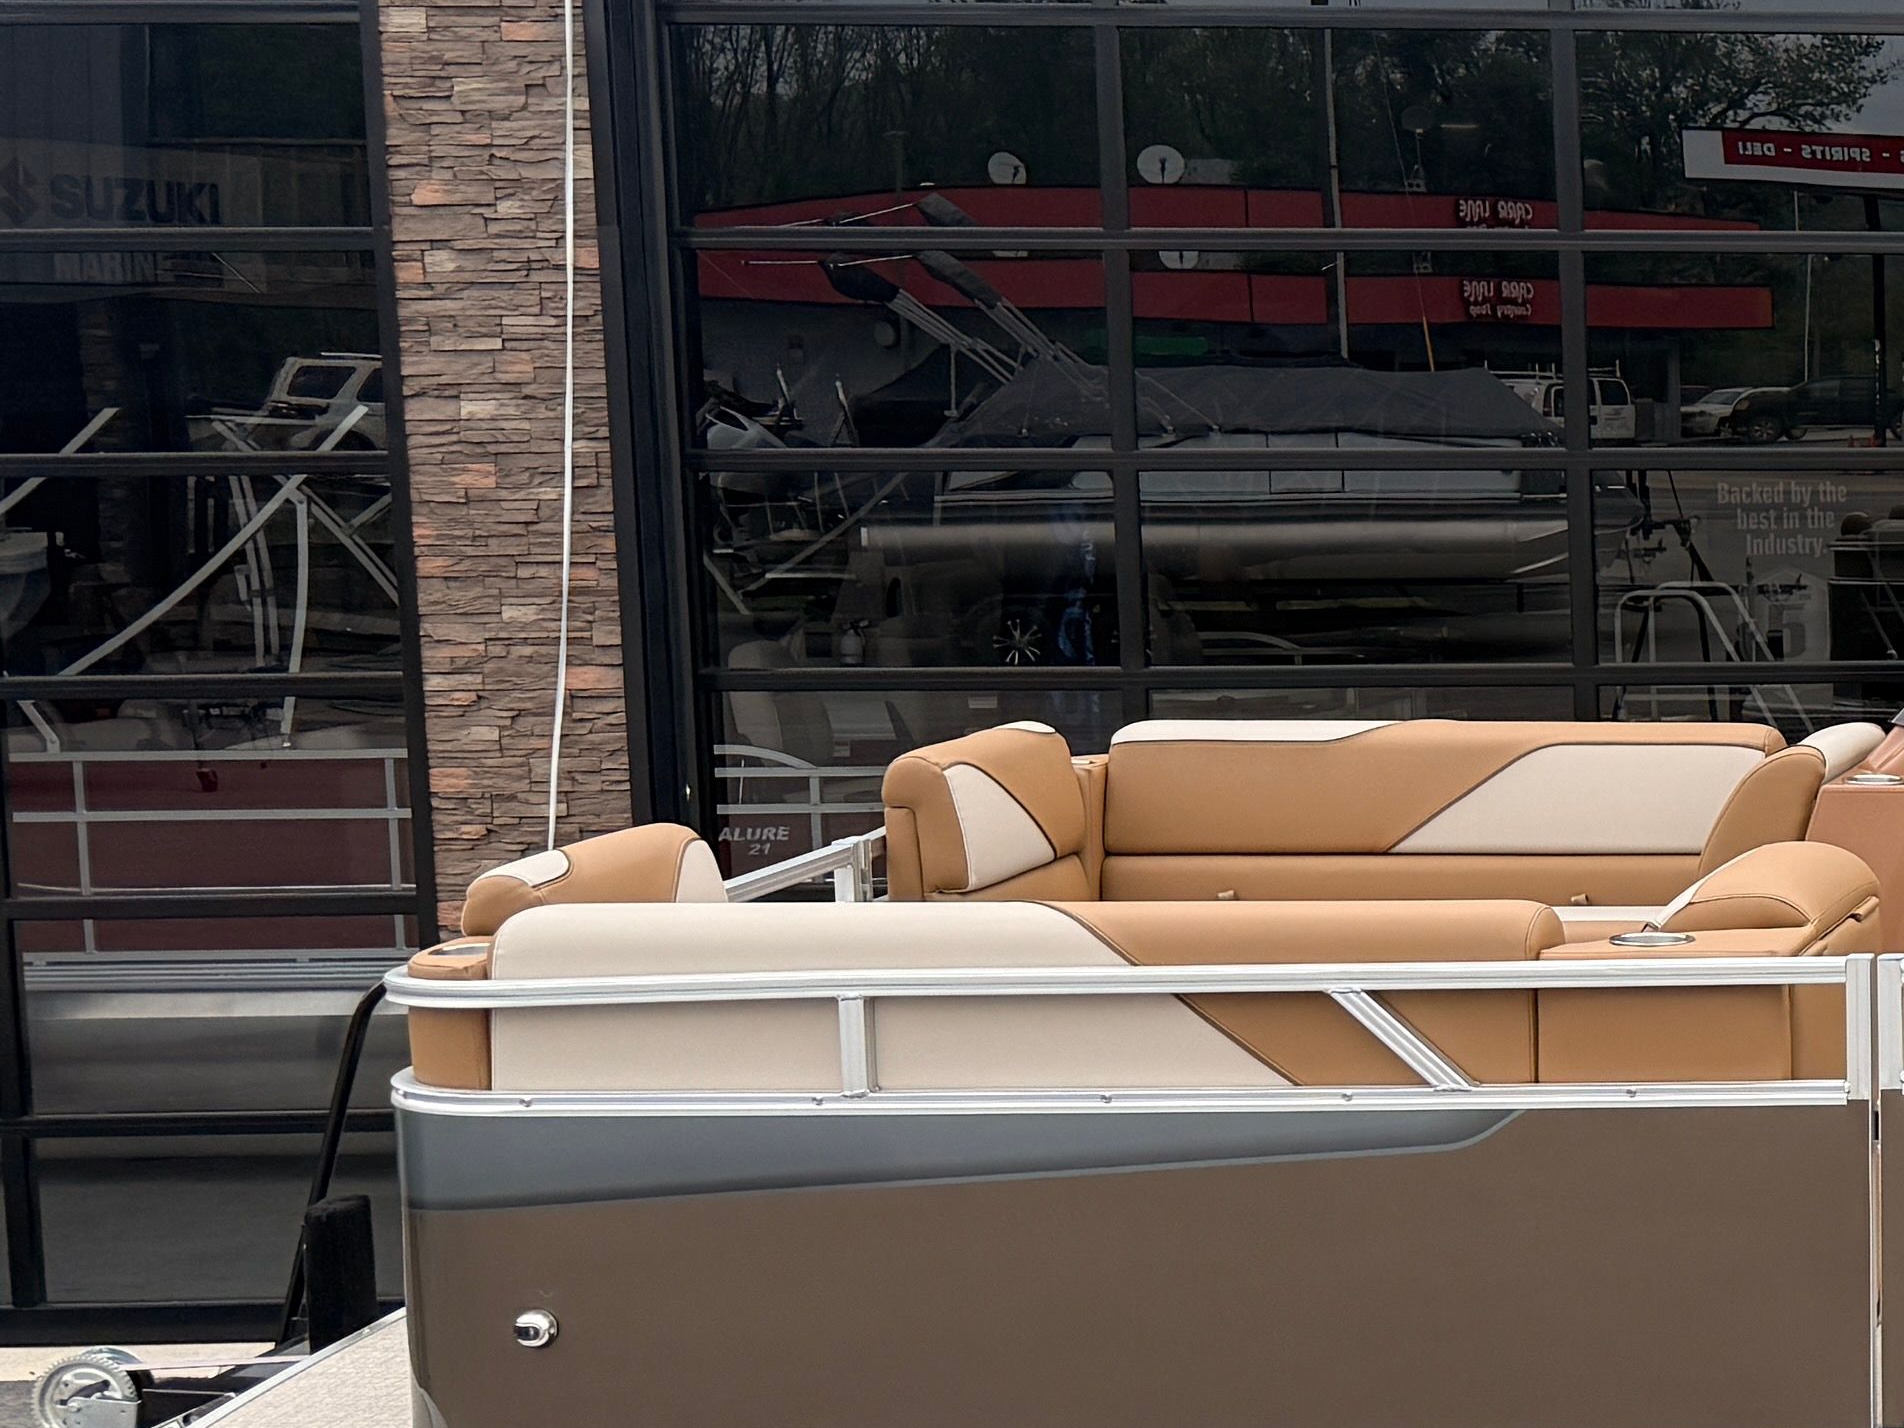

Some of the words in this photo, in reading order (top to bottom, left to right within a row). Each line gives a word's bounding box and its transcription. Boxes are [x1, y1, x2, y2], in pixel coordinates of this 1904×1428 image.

[50, 173, 221, 225] SUZUKI
[1716, 481, 1785, 504] Backed
[1790, 480, 1812, 507] by
[1818, 480, 1848, 503] the
[1736, 506, 1777, 530] best
[1783, 506, 1800, 529] in
[1806, 505, 1835, 529] the
[1745, 532, 1828, 558] Industry.
[718, 826, 791, 842] ALURE
[748, 843, 771, 856] 21
